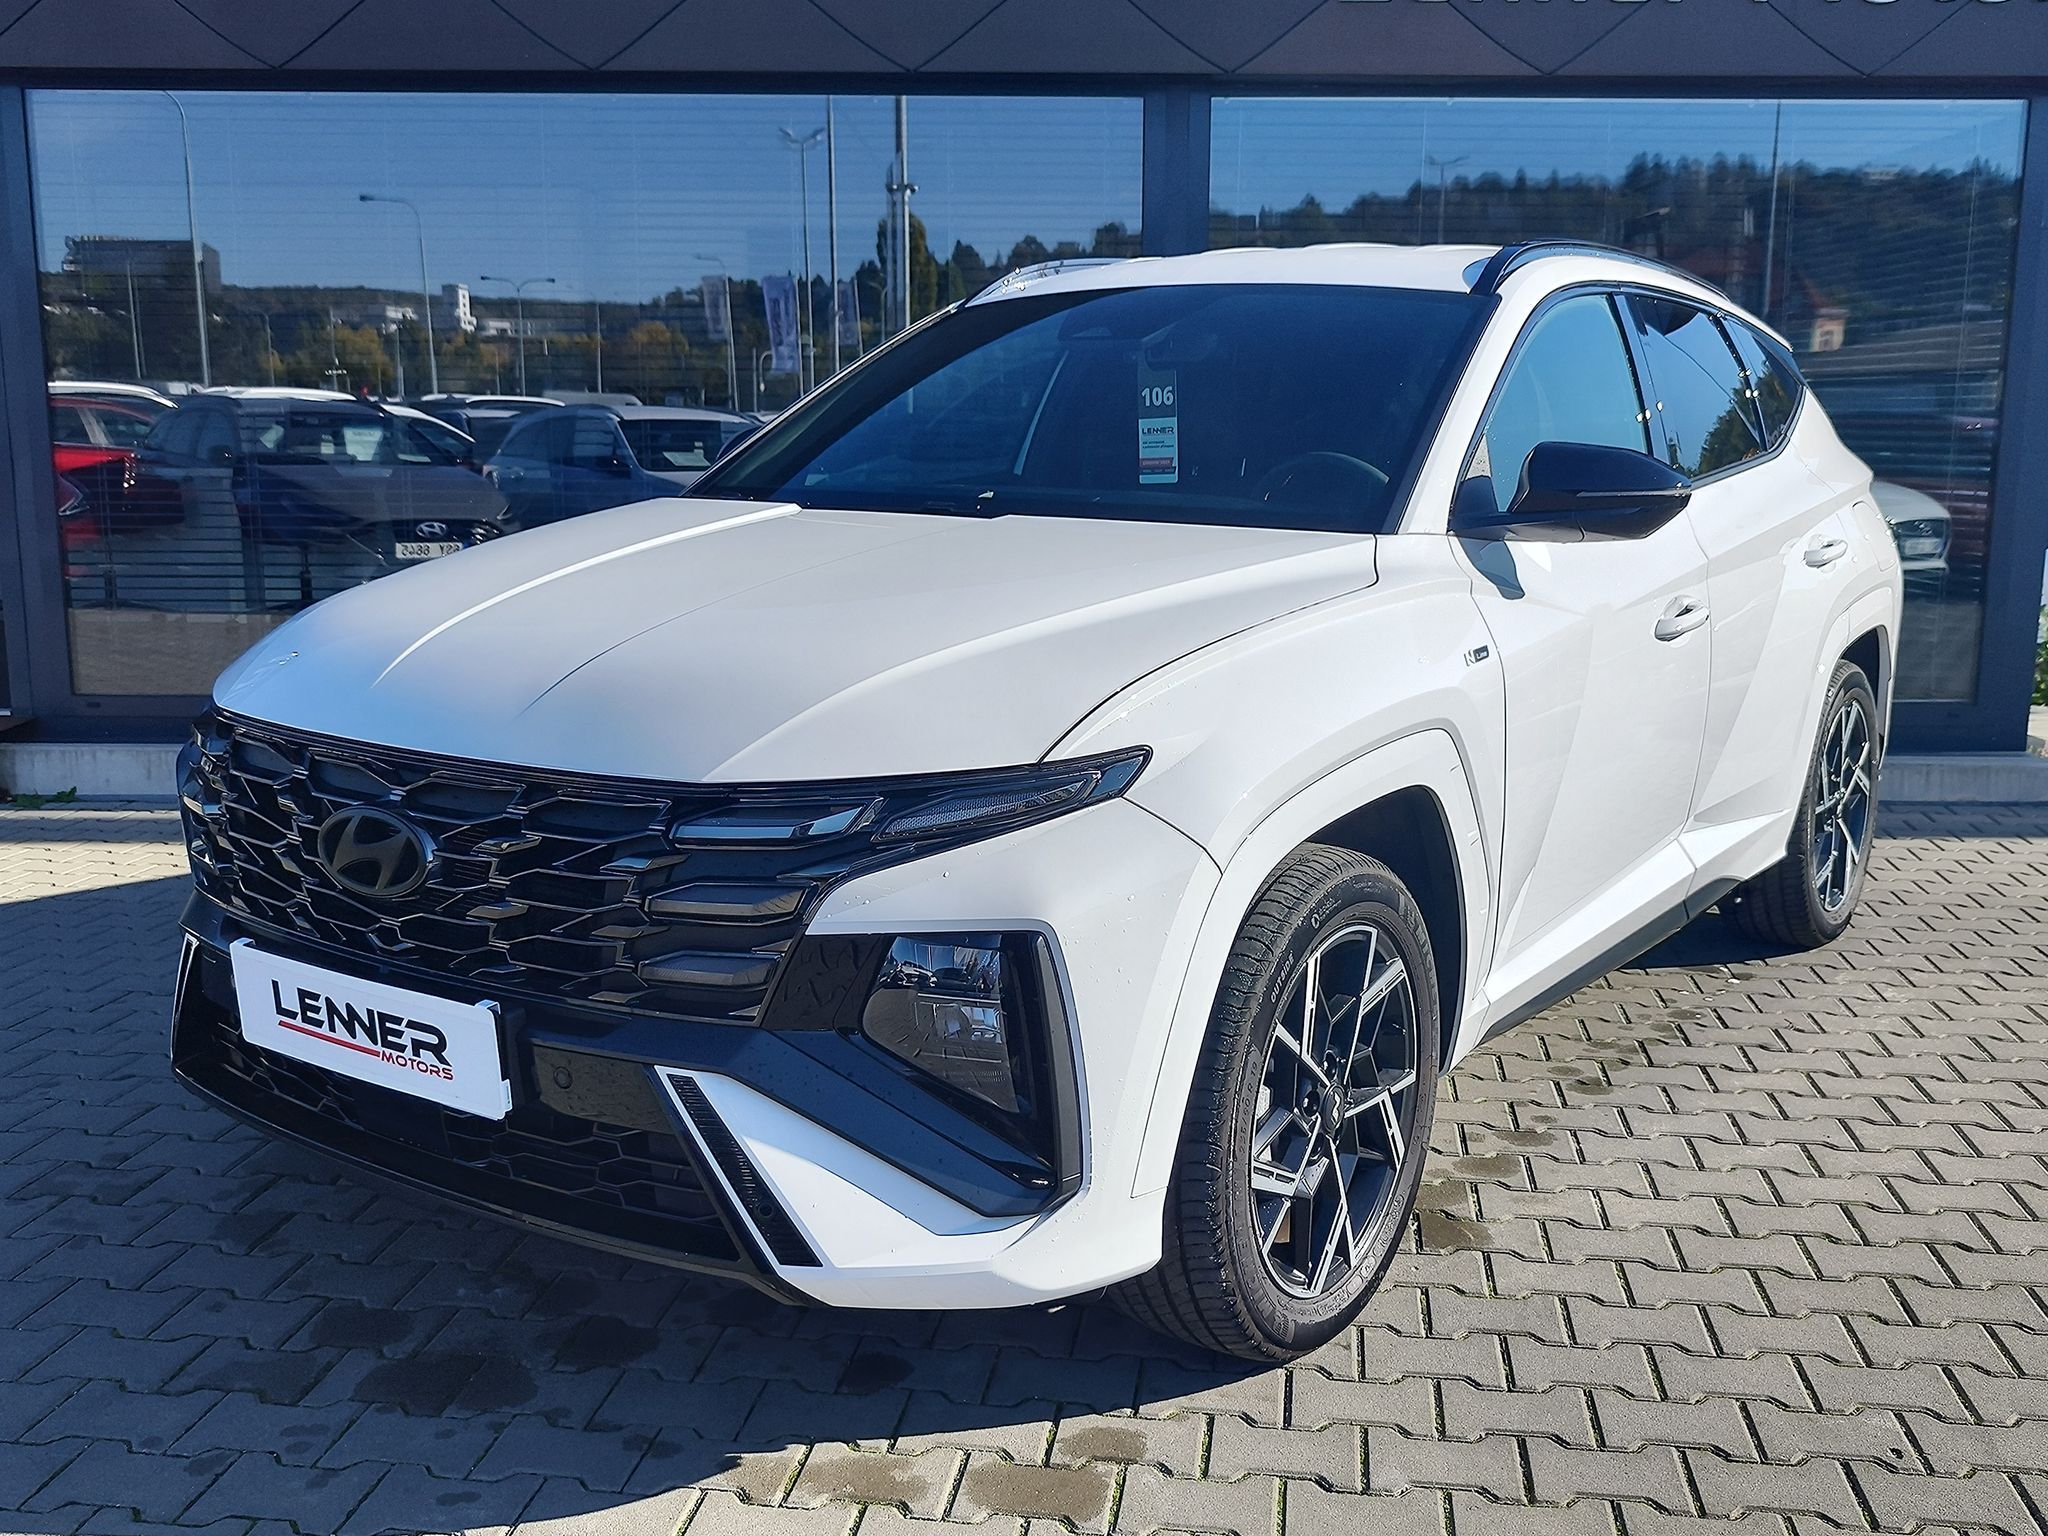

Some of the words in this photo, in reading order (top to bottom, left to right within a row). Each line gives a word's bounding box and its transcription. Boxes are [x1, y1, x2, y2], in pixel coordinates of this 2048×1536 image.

[1141, 386, 1174, 407] 106
[1270, 952, 1294, 1003] OUTSIDE
[271, 979, 453, 1067] LENNER
[381, 1050, 454, 1081] MOTORS
